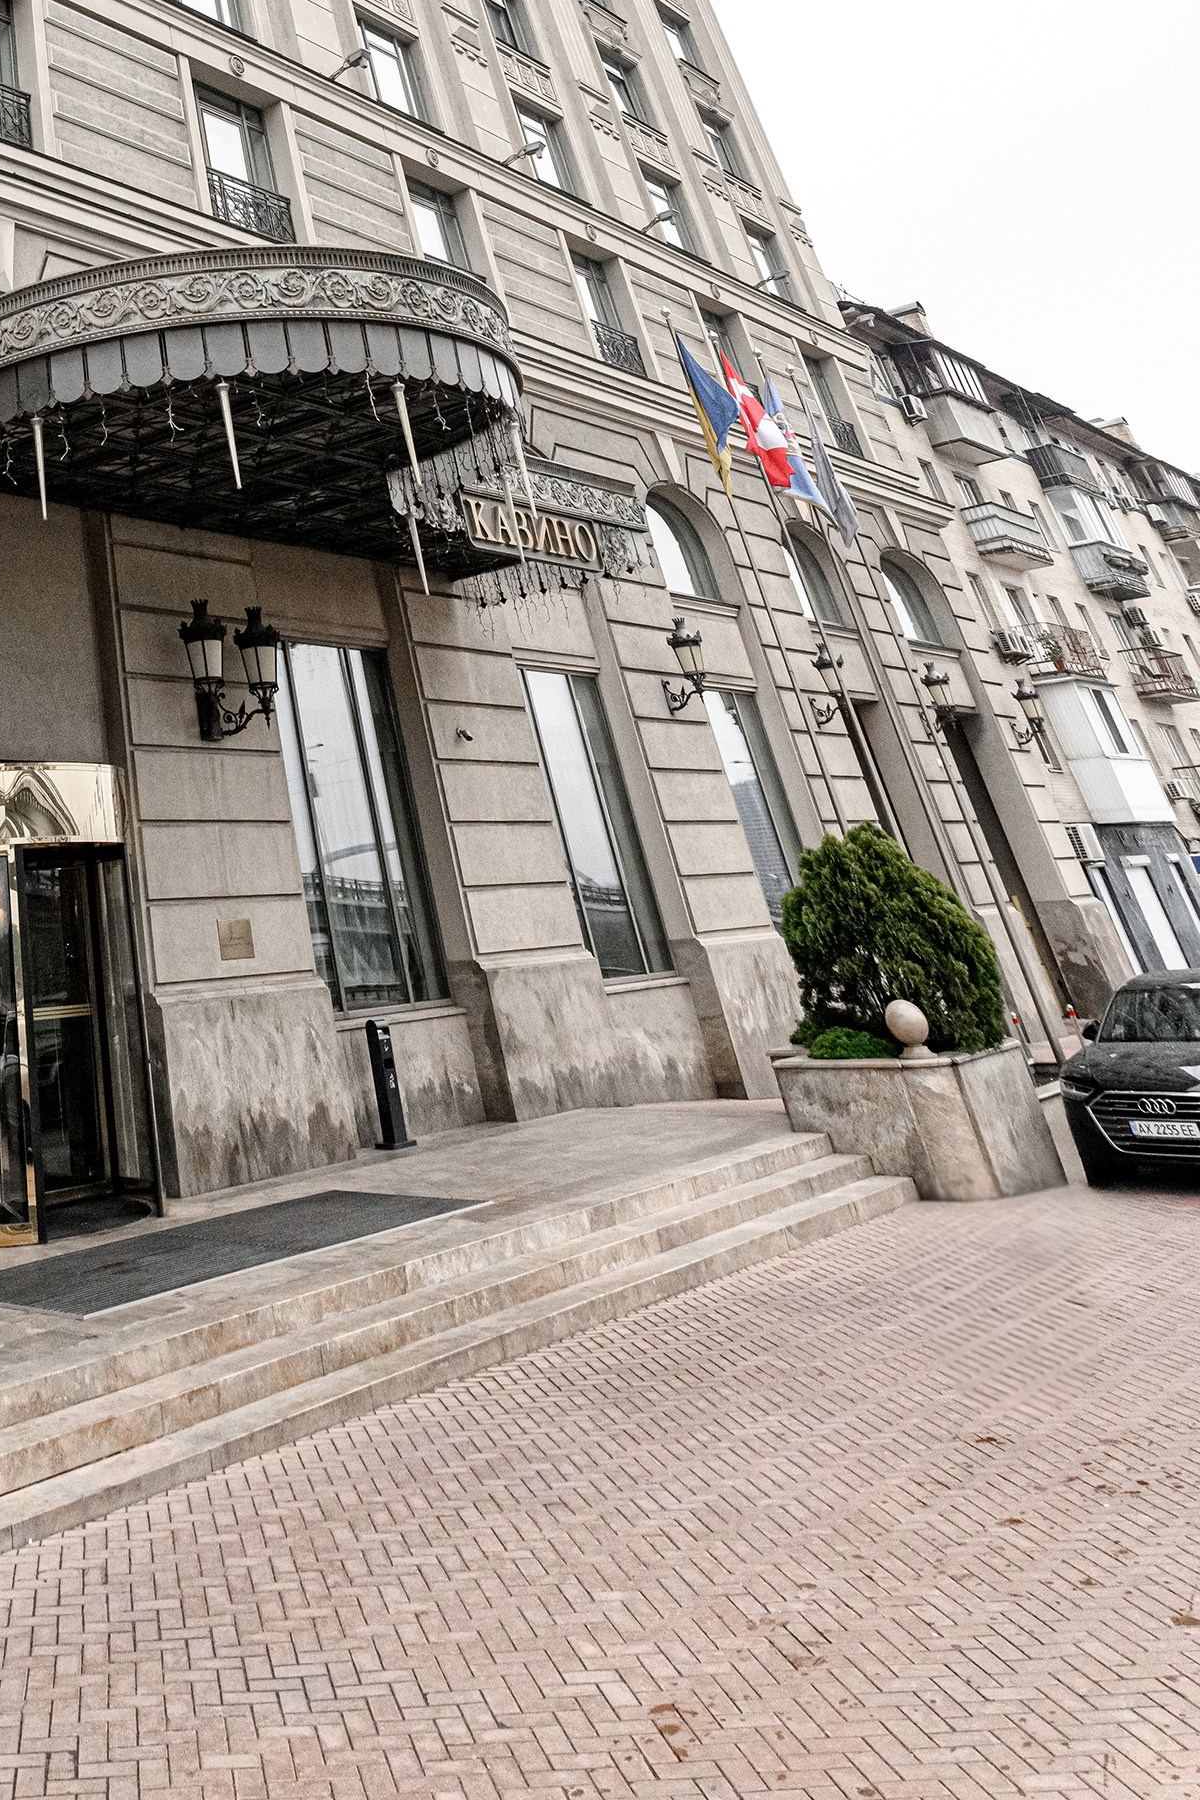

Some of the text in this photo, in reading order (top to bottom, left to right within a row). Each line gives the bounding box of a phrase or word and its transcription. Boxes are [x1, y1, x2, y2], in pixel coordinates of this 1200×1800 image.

[1138, 1123, 1197, 1137] AX 2255 EE
